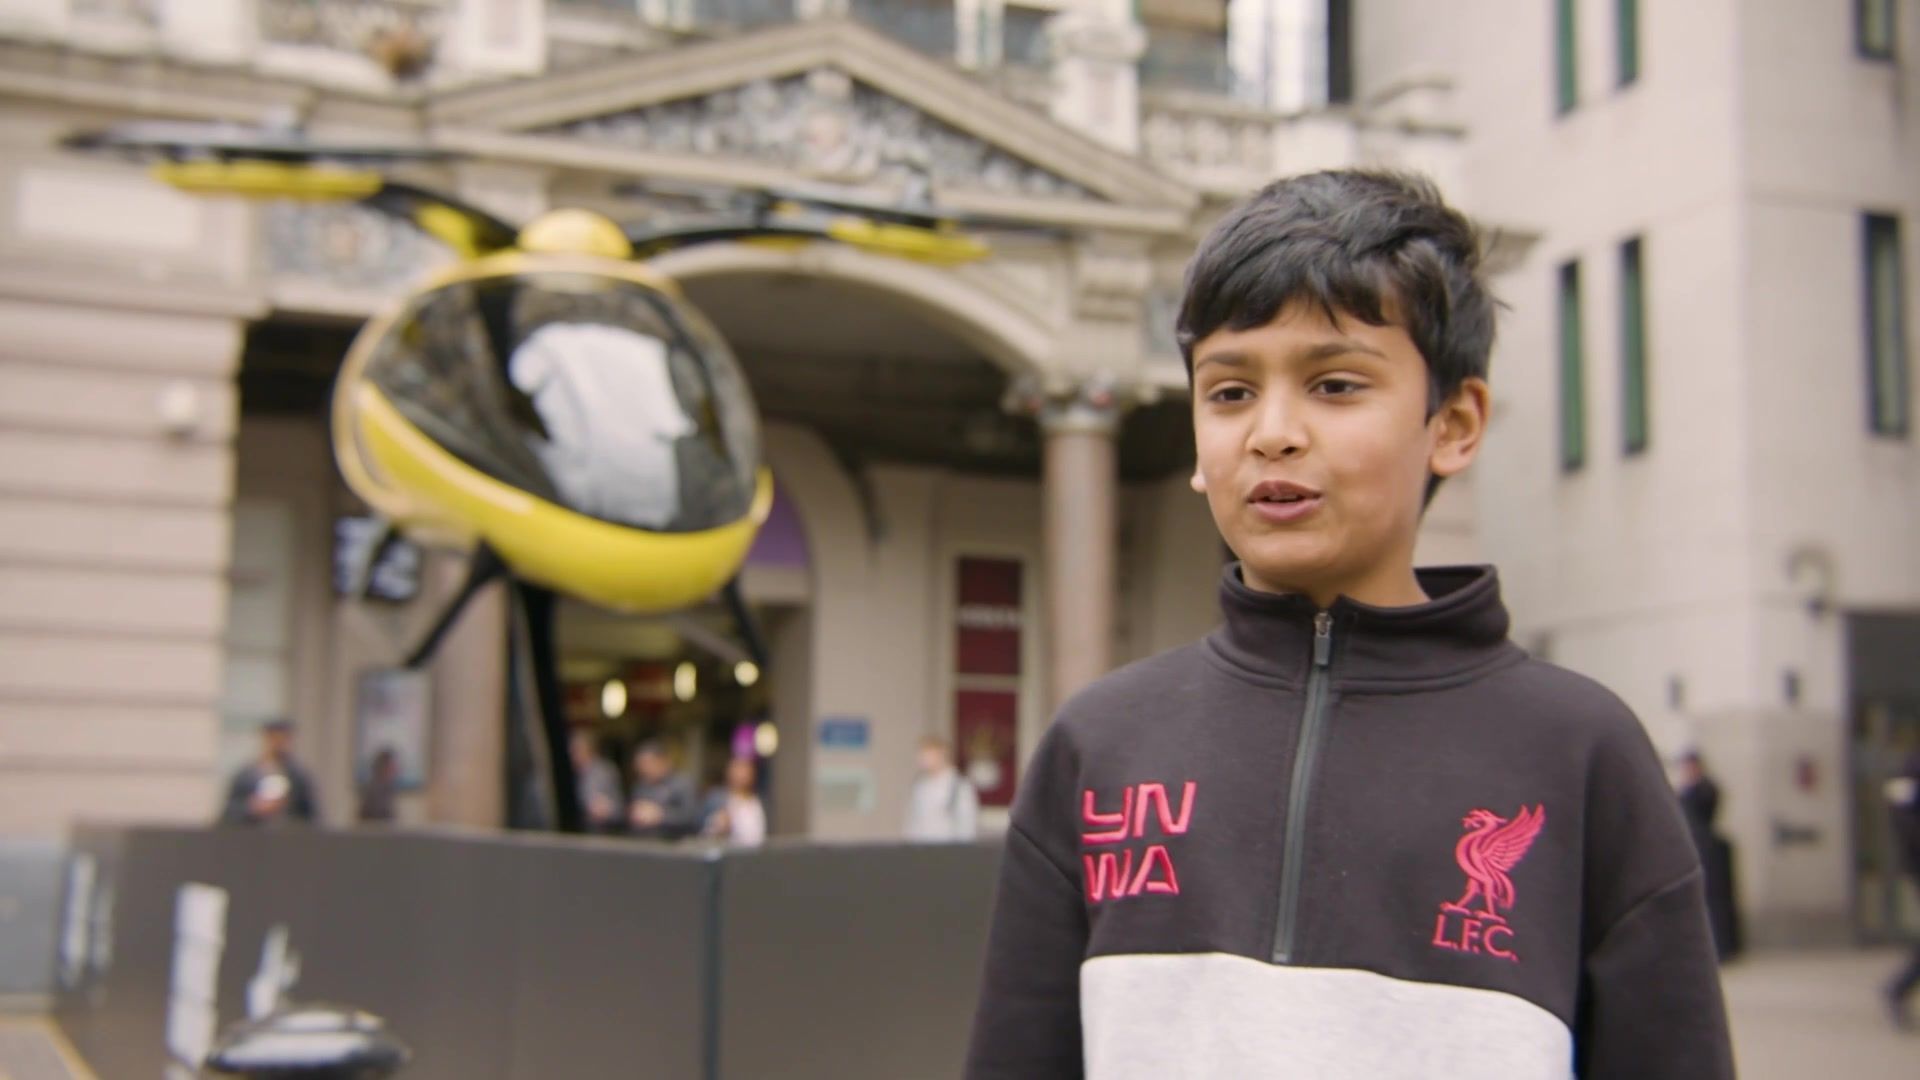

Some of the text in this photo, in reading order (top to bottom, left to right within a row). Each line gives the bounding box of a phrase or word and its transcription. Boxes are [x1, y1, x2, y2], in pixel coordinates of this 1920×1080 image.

[1081, 780, 1197, 845] YN
[1083, 845, 1180, 902] WA
[1432, 913, 1519, 962] L.F.C.
